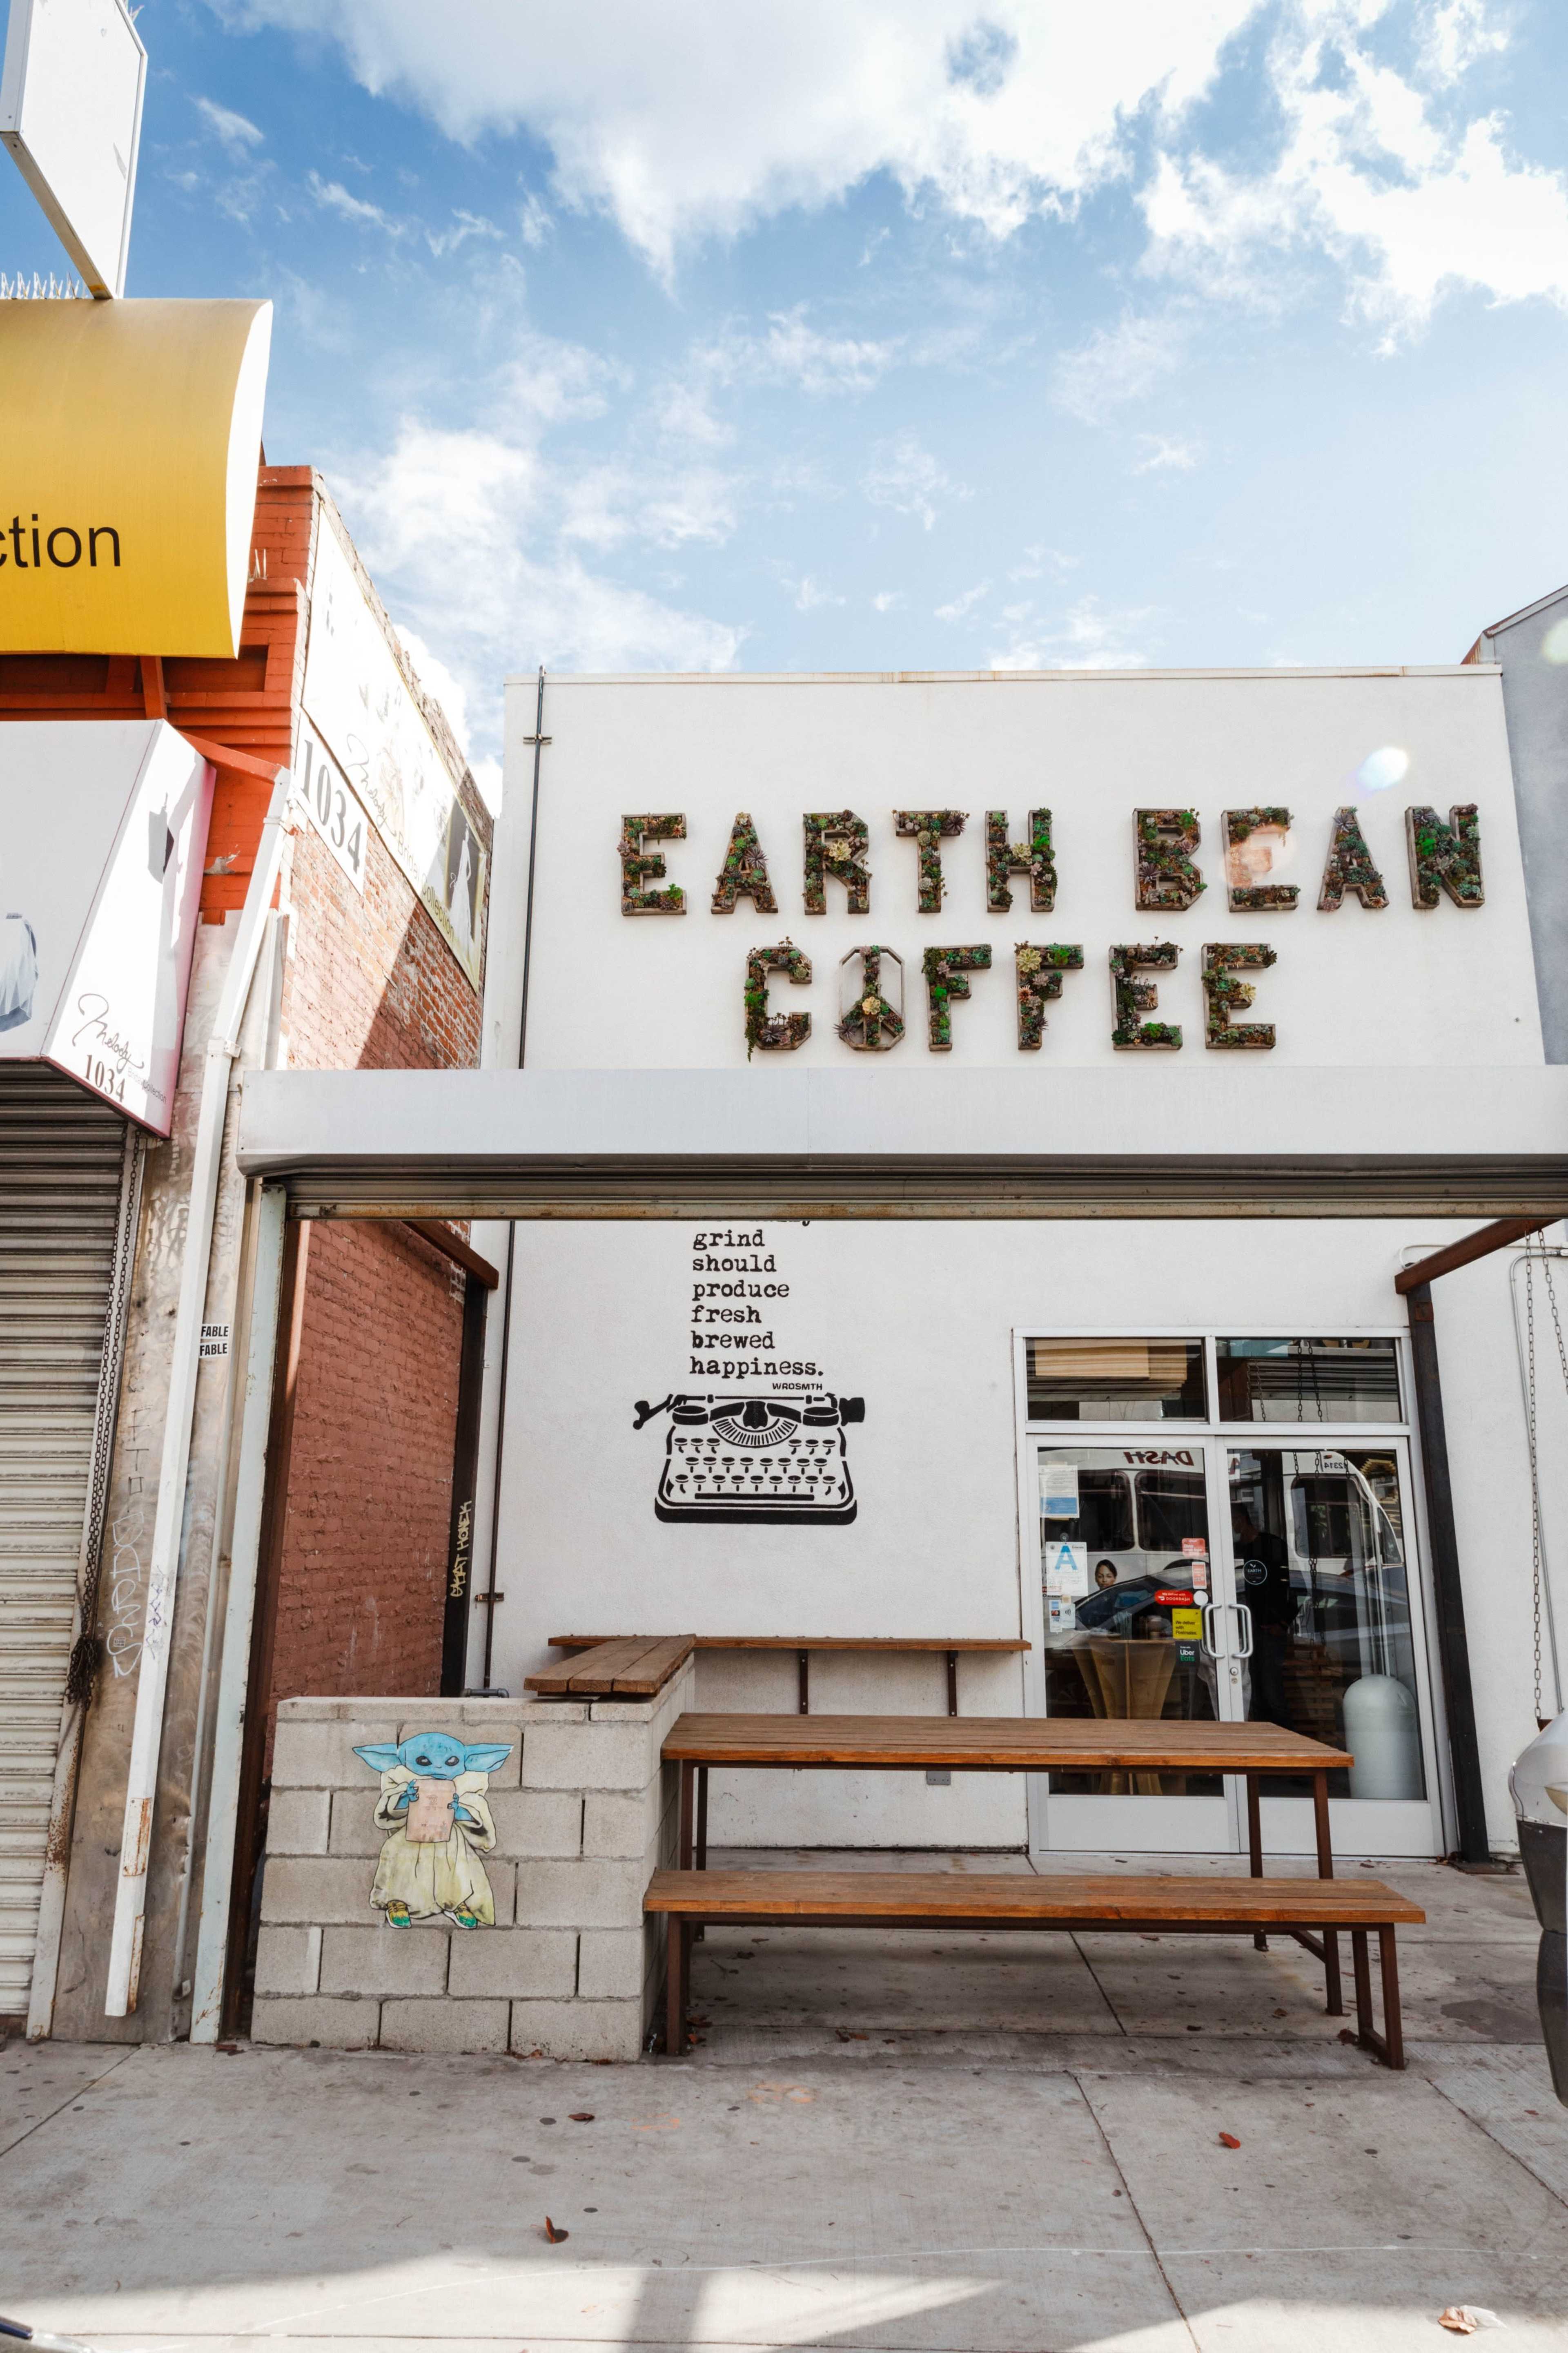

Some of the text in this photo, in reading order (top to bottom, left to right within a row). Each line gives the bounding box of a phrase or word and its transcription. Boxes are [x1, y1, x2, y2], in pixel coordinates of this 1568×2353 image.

[301, 739, 363, 874] 1034
[617, 803, 1486, 916] EARTH BEAN
[744, 939, 1278, 1051] COFFEE
[72, 993, 144, 1074] Melody
[85, 1055, 125, 1102] 1034
[143, 1079, 167, 1104] Collection
[693, 1229, 765, 1250] grind
[693, 1255, 777, 1272] should
[692, 1280, 790, 1300] produce
[690, 1305, 762, 1323] fresh
[200, 1326, 229, 1337] FABLE
[690, 1331, 775, 1349] brewed
[200, 1343, 227, 1356] FABLE
[689, 1356, 823, 1378] happiness.
[1055, 1545, 1078, 1570] A
